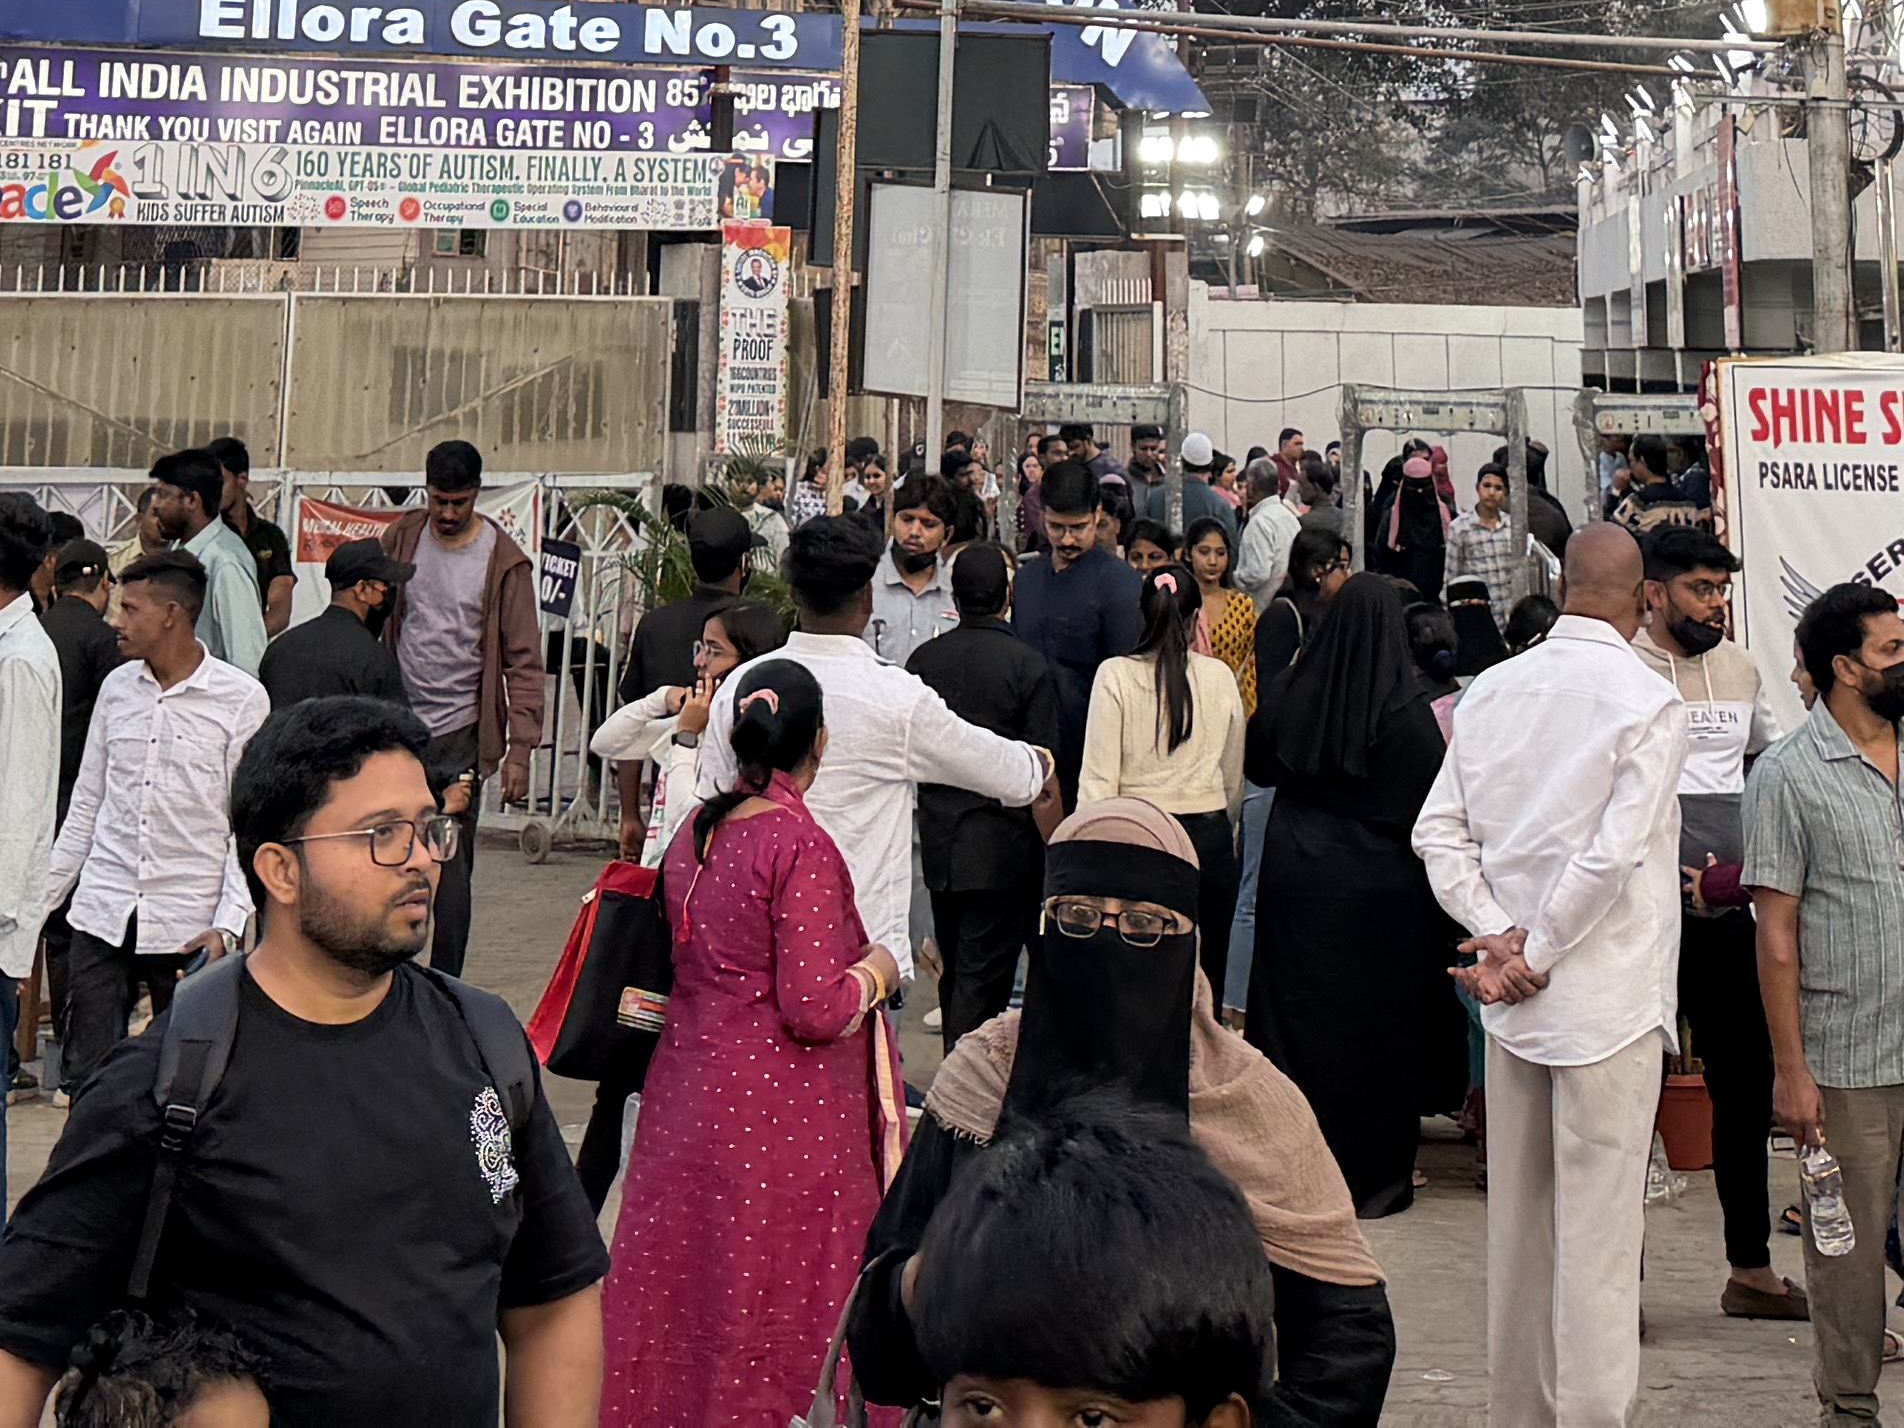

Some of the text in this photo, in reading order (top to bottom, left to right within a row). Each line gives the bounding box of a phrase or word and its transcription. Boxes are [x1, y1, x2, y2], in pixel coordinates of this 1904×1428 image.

[644, 6, 797, 61] No.3
[99, 63, 207, 103] INDIA
[220, 66, 447, 107] INDUSTRIAL
[458, 75, 656, 113] EXHIBITION
[63, 112, 150, 142] THANK
[158, 116, 211, 143] YOU
[216, 118, 282, 144] VISIT
[286, 120, 362, 145] AGAIN
[380, 116, 487, 147] ELLORA
[496, 119, 567, 149] GATE
[573, 120, 612, 150] NO
[620, 135, 630, 143] -
[638, 122, 655, 150] 3
[38, 153, 73, 170] 181
[296, 150, 329, 178] 160
[409, 153, 433, 180] OF
[438, 154, 520, 182] AUTISM.
[526, 155, 608, 183] FINALLY.
[613, 156, 627, 183] A
[633, 157, 713, 184] SYSTEM.
[132, 144, 294, 202] 1 IN 6
[398, 180, 427, 192] Global
[428, 181, 468, 193] Pediatric
[471, 181, 524, 195] Therapeutic
[527, 183, 570, 197] Operating
[572, 184, 604, 197] System
[137, 202, 285, 224] KIDS SUFFER AUTISM
[350, 196, 389, 210] Speech
[423, 200, 486, 214] Occupational
[513, 201, 548, 213] Special
[350, 210, 395, 225] Therapy
[423, 212, 464, 226] Therapy
[513, 213, 560, 225] Education
[584, 213, 638, 225] Modification
[731, 307, 778, 338] THE
[732, 337, 774, 361] PROOF
[1748, 387, 1868, 450] SHINE
[1758, 462, 1818, 491] PSARA
[1822, 464, 1900, 494] LICENSE
